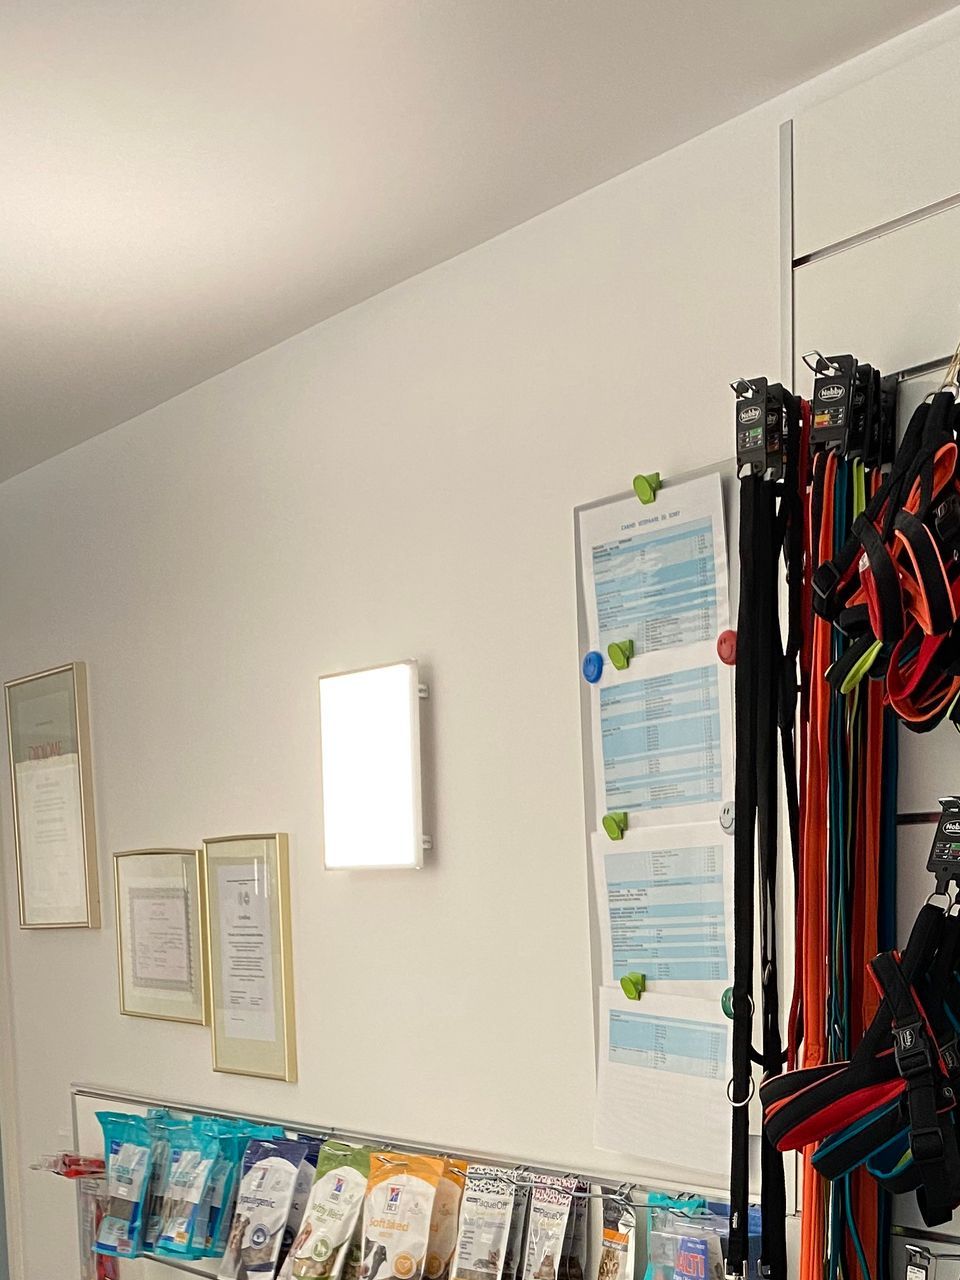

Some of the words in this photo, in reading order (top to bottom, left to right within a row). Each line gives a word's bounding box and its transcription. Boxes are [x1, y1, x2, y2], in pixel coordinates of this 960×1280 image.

[821, 386, 844, 399] Nobby
[741, 407, 760, 420] Nobby
[676, 1252, 705, 1279] ALTI
